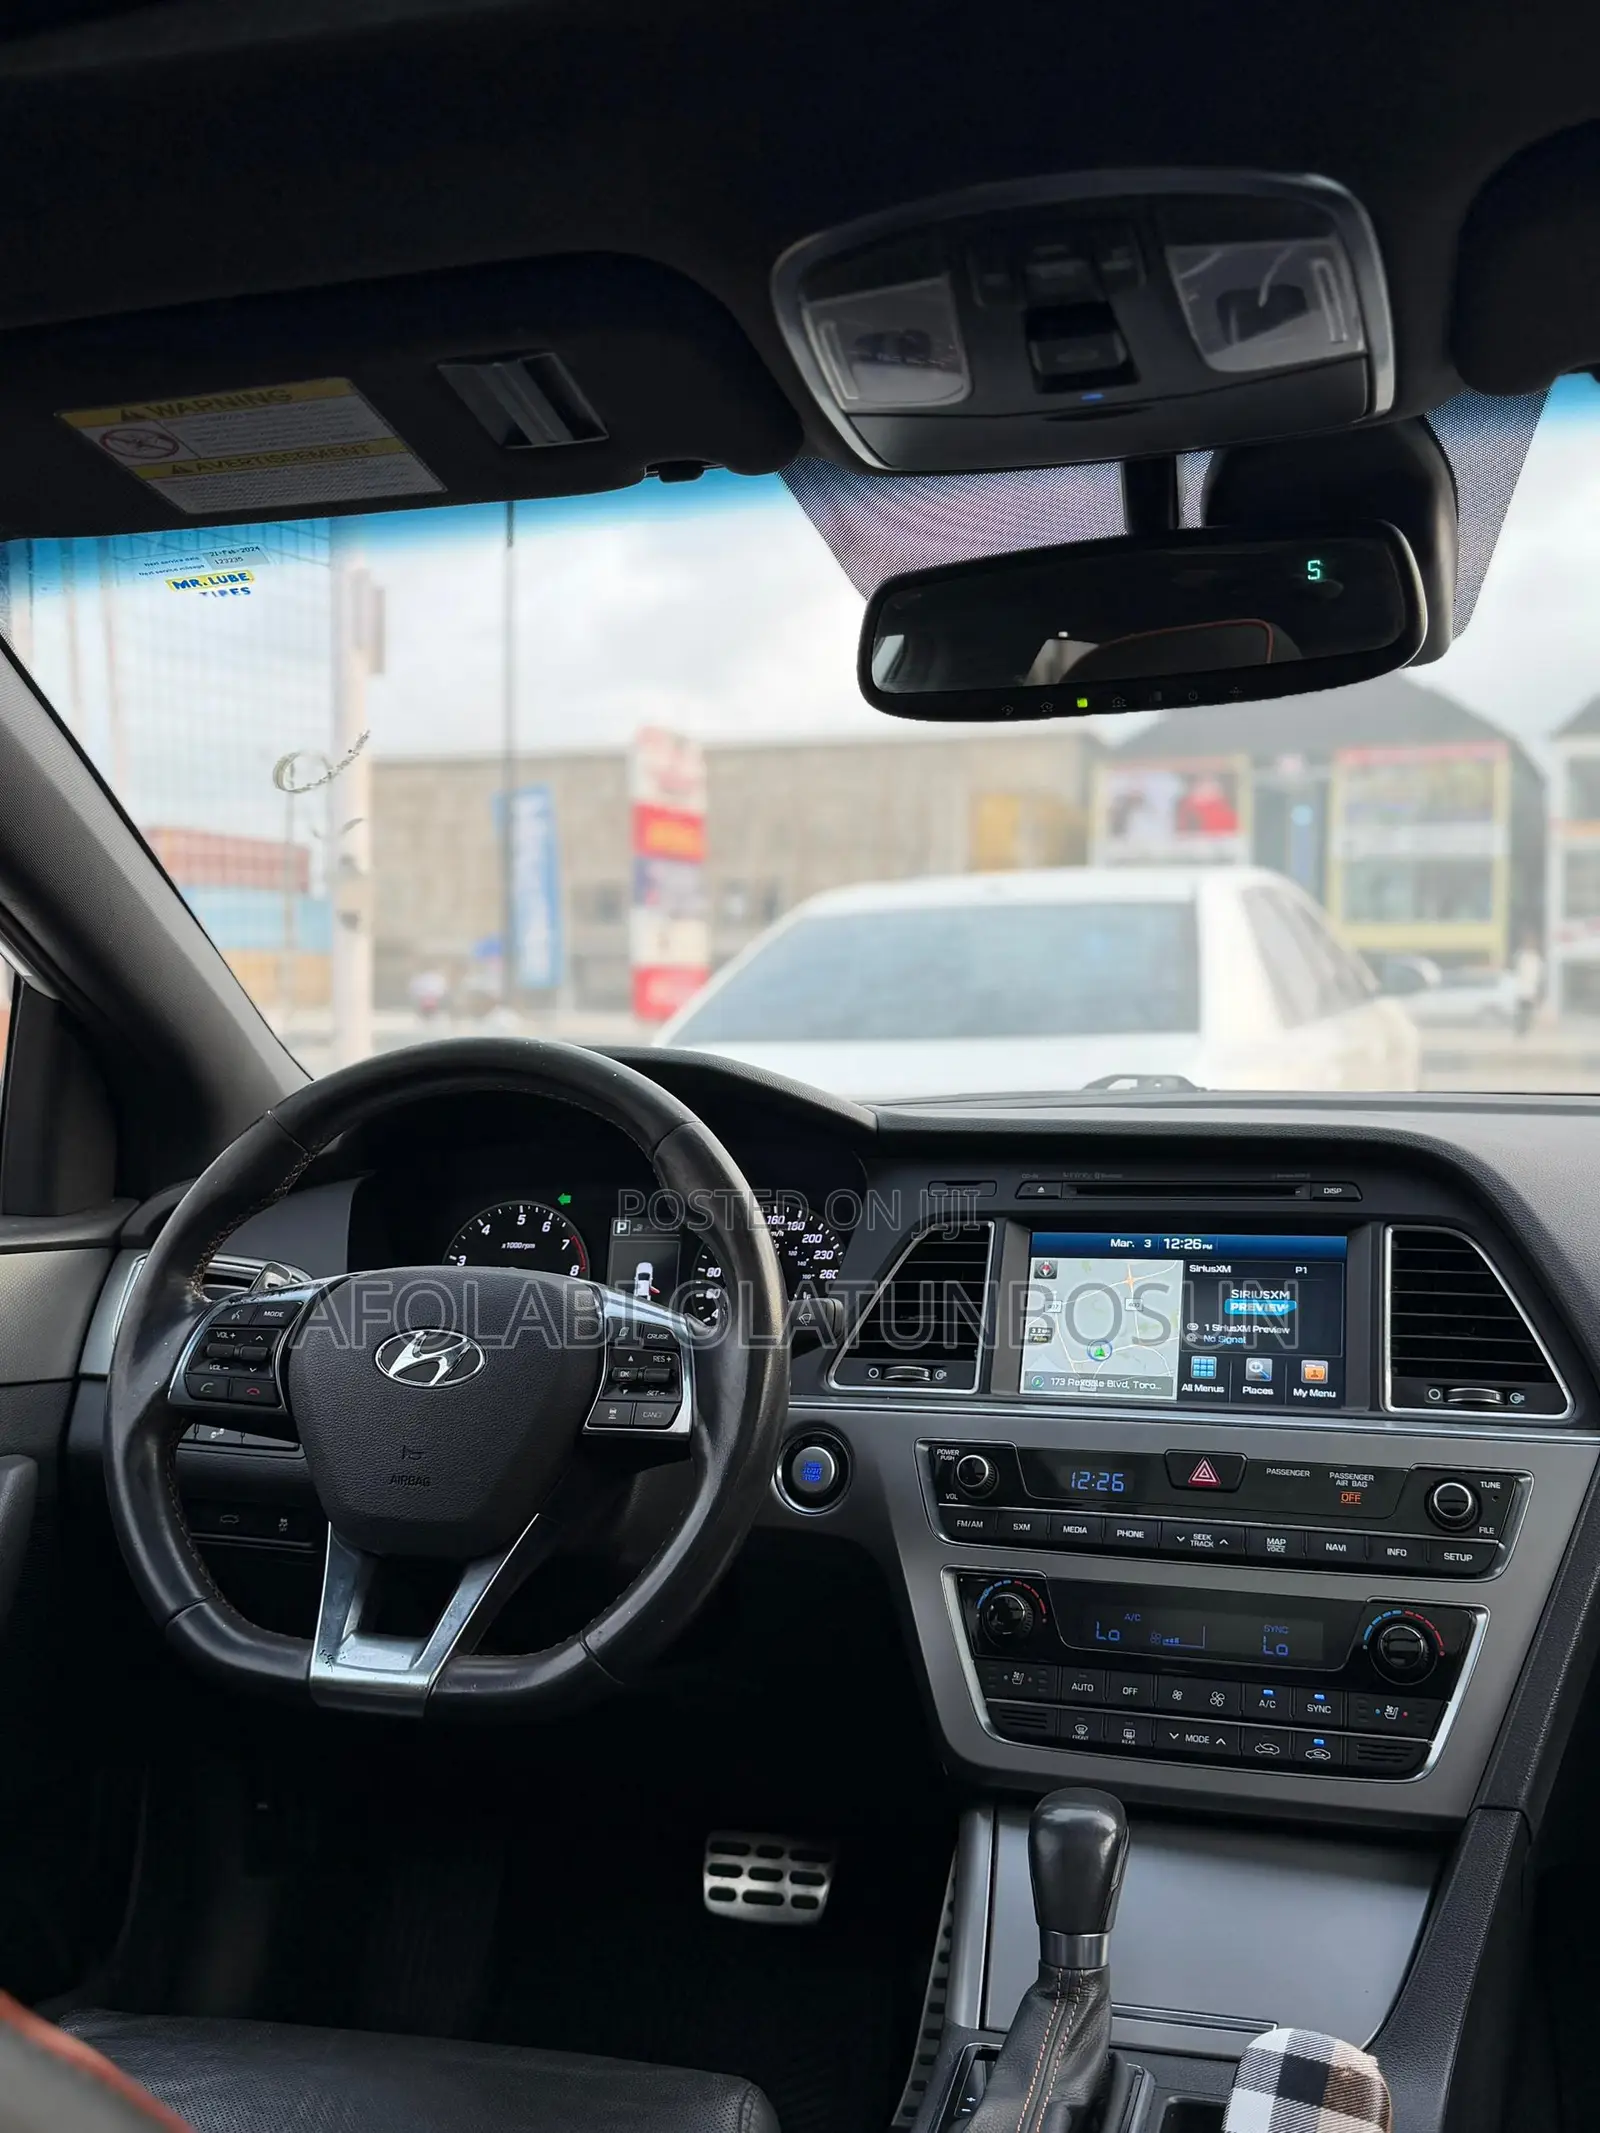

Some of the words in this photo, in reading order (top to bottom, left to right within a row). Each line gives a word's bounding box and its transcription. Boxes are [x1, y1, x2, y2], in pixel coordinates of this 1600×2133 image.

[146, 388, 293, 417] WARNING
[172, 577, 207, 590] MR.
[208, 572, 250, 586] LUBE
[1323, 1186, 1342, 1195] DISP
[516, 1214, 527, 1225] 5
[766, 1215, 785, 1225] 160
[481, 1224, 491, 1235] 4
[542, 1221, 551, 1232] 6
[616, 1221, 627, 1234] P
[786, 1221, 806, 1231] 180
[802, 1233, 823, 1243] 200
[1110, 1238, 1135, 1248] Mar.
[1143, 1239, 1152, 1248] 3
[561, 1239, 570, 1250] 7
[1163, 1237, 1202, 1250] 12:26
[813, 1250, 834, 1260] 230
[457, 1255, 467, 1266] 3
[569, 1265, 580, 1276] 8
[706, 1267, 721, 1277] 80
[1189, 1264, 1232, 1274] SiriusXM
[1295, 1266, 1308, 1274] P1
[705, 1288, 720, 1299] 60
[1231, 1289, 1291, 1300] SIRIUSXM
[1230, 1303, 1289, 1312] PREVIEW
[263, 1310, 285, 1318] MODE
[1204, 1324, 1209, 1332] 1
[1211, 1323, 1251, 1333] SiriusXM
[1252, 1325, 1291, 1334] Preview
[1203, 1335, 1216, 1343] No
[1218, 1335, 1246, 1345] Signal
[652, 1355, 665, 1363] RES
[1051, 1378, 1066, 1386] 173
[1181, 1383, 1193, 1392] All
[1194, 1384, 1225, 1393] Menus
[1242, 1386, 1274, 1396] Places
[1293, 1388, 1308, 1398] My
[1309, 1389, 1336, 1398] Menu
[936, 1448, 960, 1457] POWER
[1266, 1467, 1310, 1478] PASSENGER
[1329, 1471, 1374, 1482] PASSENGER
[1070, 1471, 1125, 1492] 12:26
[1335, 1479, 1348, 1487] AIR
[1351, 1480, 1368, 1488] BAG
[1480, 1481, 1501, 1489] TUNE
[1341, 1493, 1361, 1503] OFF
[956, 1519, 983, 1529] FM/AM
[1013, 1522, 1031, 1531] SXM
[1063, 1525, 1087, 1534] MEDIA
[1117, 1529, 1144, 1539] PHONE
[1479, 1526, 1495, 1535] FILE
[1193, 1533, 1212, 1541] SEEK
[1266, 1537, 1286, 1546] MAP
[1190, 1540, 1214, 1548] TRACK
[1325, 1543, 1347, 1552] NAVI
[1387, 1547, 1407, 1557] INFO
[1443, 1552, 1473, 1562] SETUP
[1124, 1612, 1141, 1622] A/C
[1095, 1621, 1120, 1641] Lo
[1263, 1624, 1289, 1634] SYNC
[1262, 1635, 1288, 1655] Lo
[1071, 1682, 1094, 1692] AUTO
[1122, 1686, 1138, 1696] OFF
[1258, 1699, 1276, 1709] A/C
[1306, 1703, 1331, 1714] SYNC
[1185, 1734, 1210, 1744] MODE
